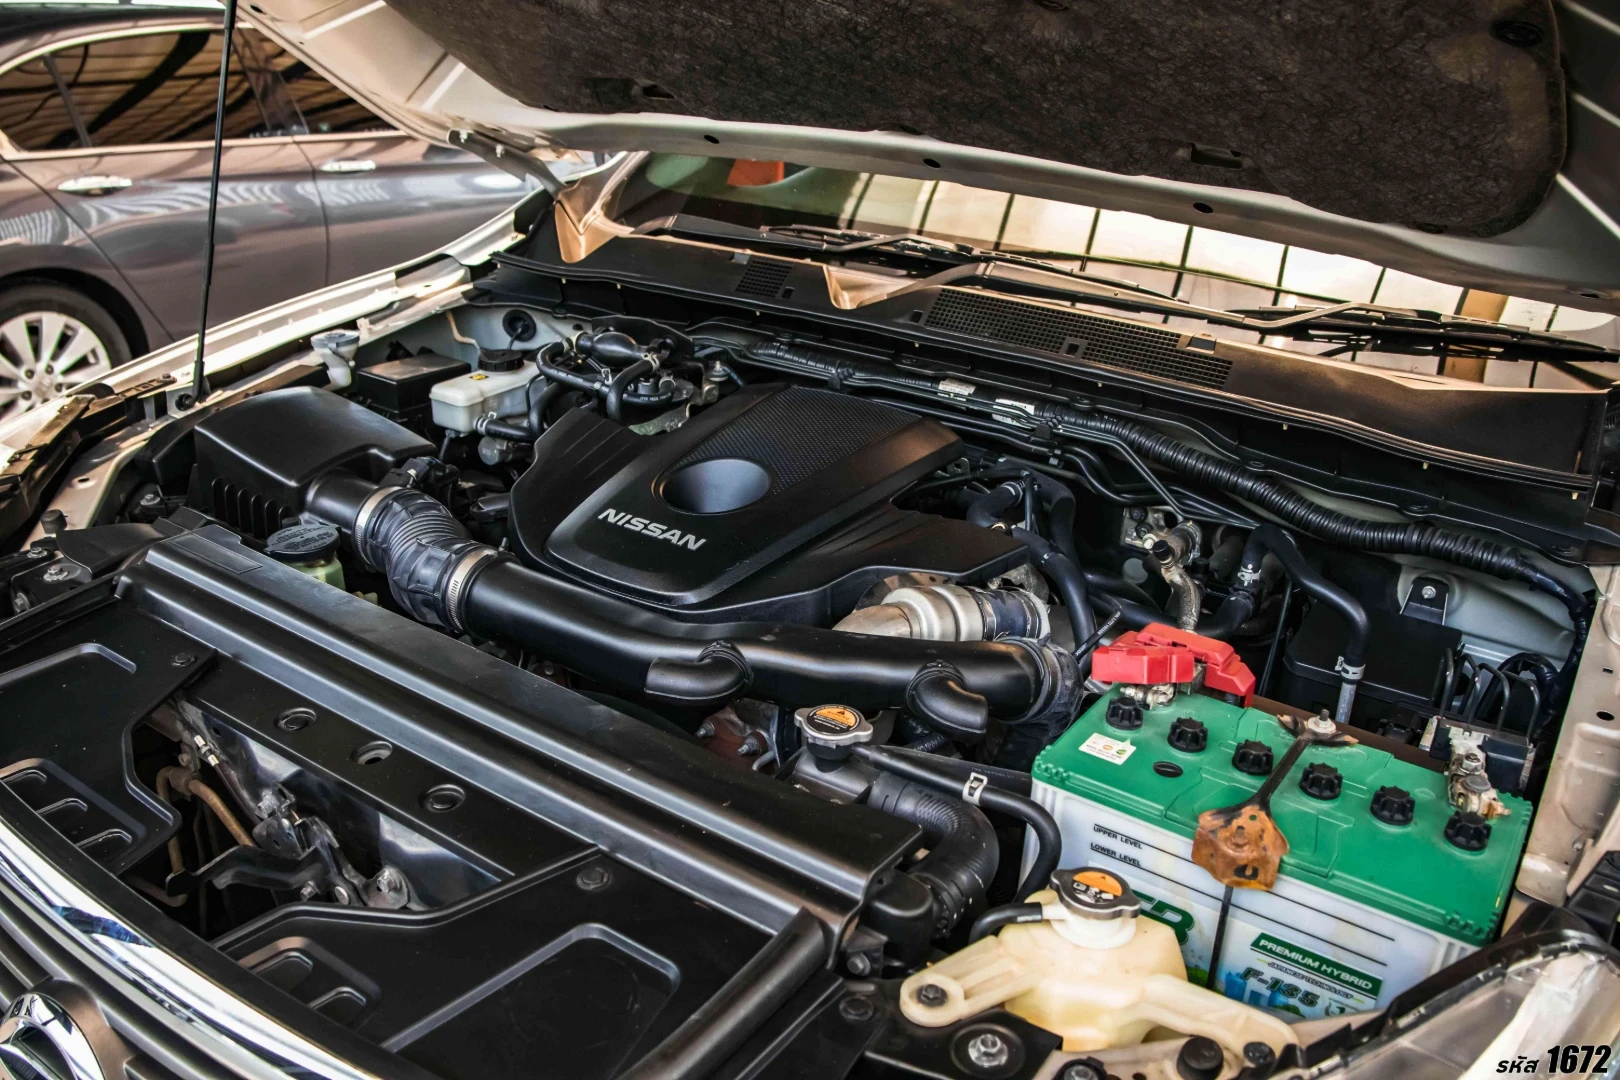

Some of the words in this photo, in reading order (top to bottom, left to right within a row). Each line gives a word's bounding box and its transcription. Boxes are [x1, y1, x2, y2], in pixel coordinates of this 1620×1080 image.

[598, 508, 707, 551] NISSAN
[1090, 841, 1117, 857] LOWER
[1119, 853, 1141, 867] LEVEL
[1093, 825, 1118, 840] UPPER
[1120, 836, 1143, 850] LEVEL
[1258, 938, 1319, 969] PREMIUM
[1320, 963, 1373, 990] HYBRID
[1268, 961, 1305, 981] JAPANESE
[1304, 974, 1354, 999] TECHNOLOGY
[1240, 966, 1321, 1008] F-135
